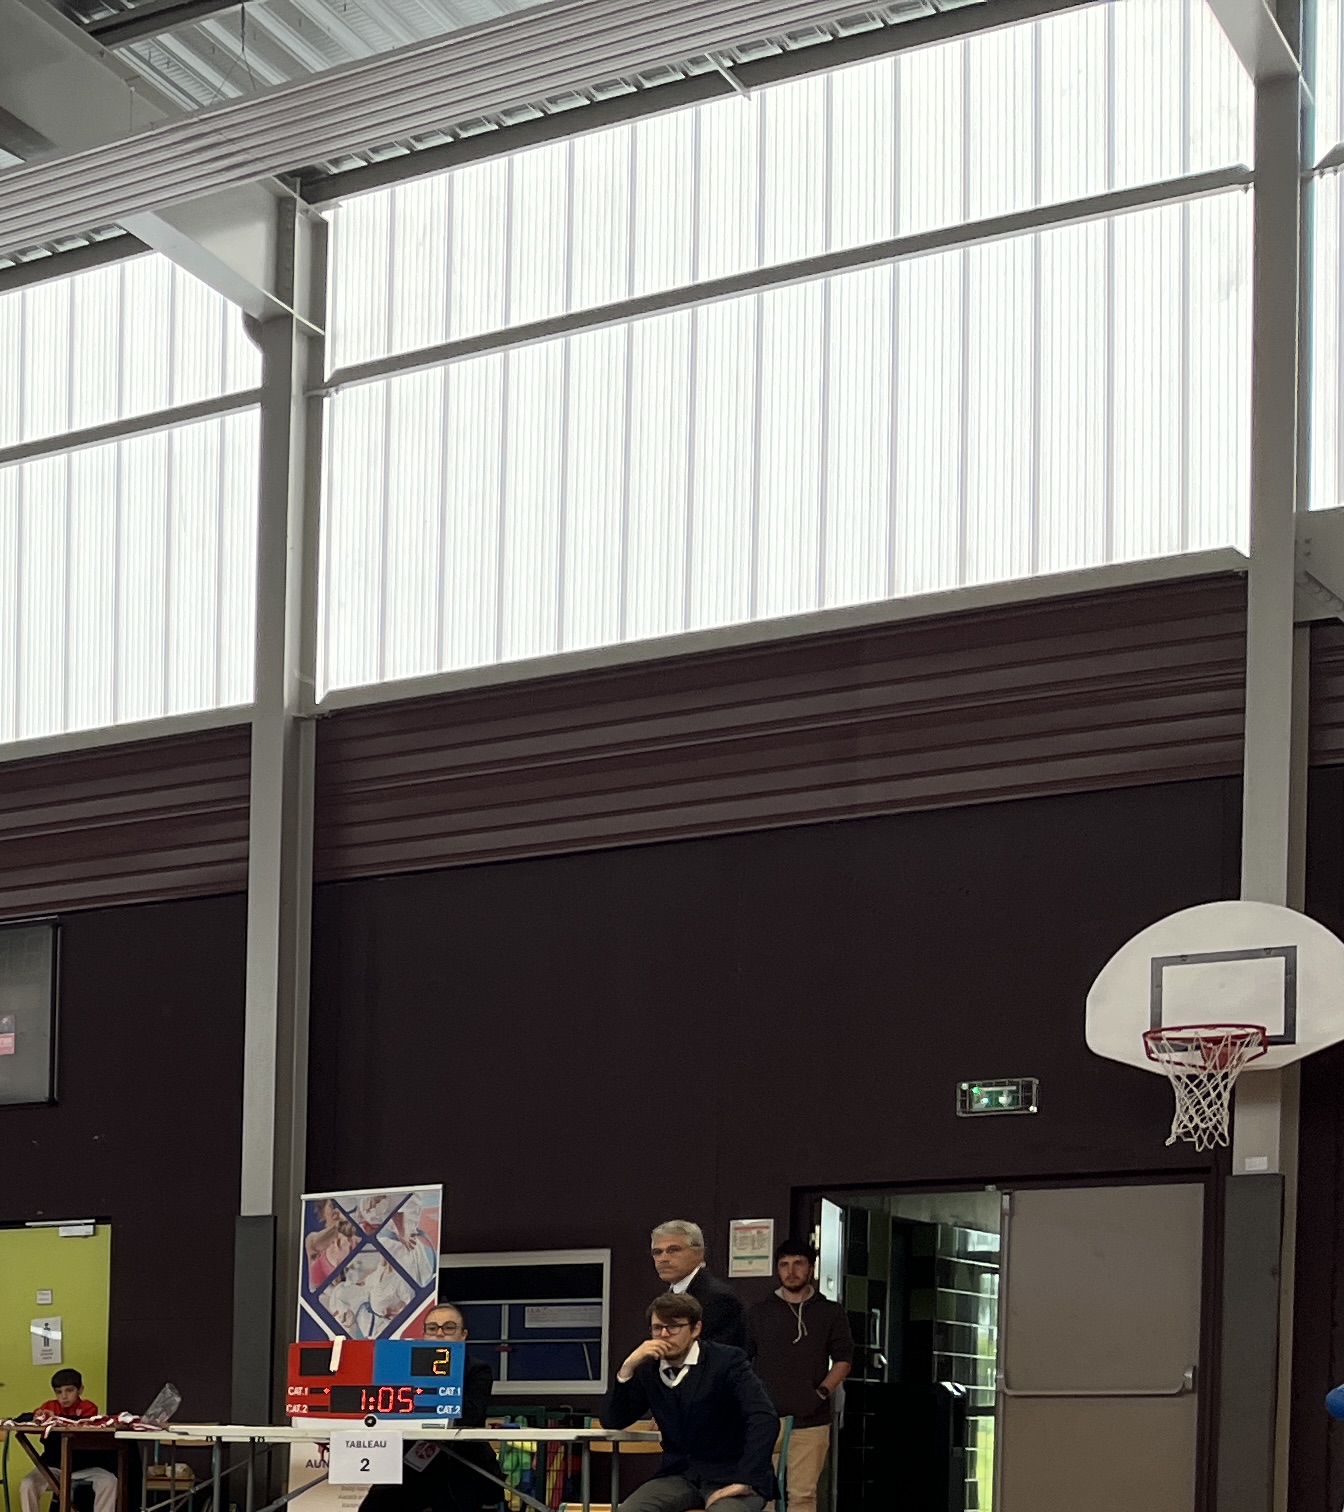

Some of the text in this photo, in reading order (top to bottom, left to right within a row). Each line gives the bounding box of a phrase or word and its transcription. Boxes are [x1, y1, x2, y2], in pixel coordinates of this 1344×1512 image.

[432, 1348, 450, 1375] 2
[288, 1386, 309, 1396] CAT.1
[360, 1386, 414, 1413] 1:05
[286, 1403, 309, 1413] CAT.2
[436, 1405, 461, 1414] CAT.2
[345, 1440, 387, 1449] TABLEAU
[359, 1457, 371, 1472] 2
